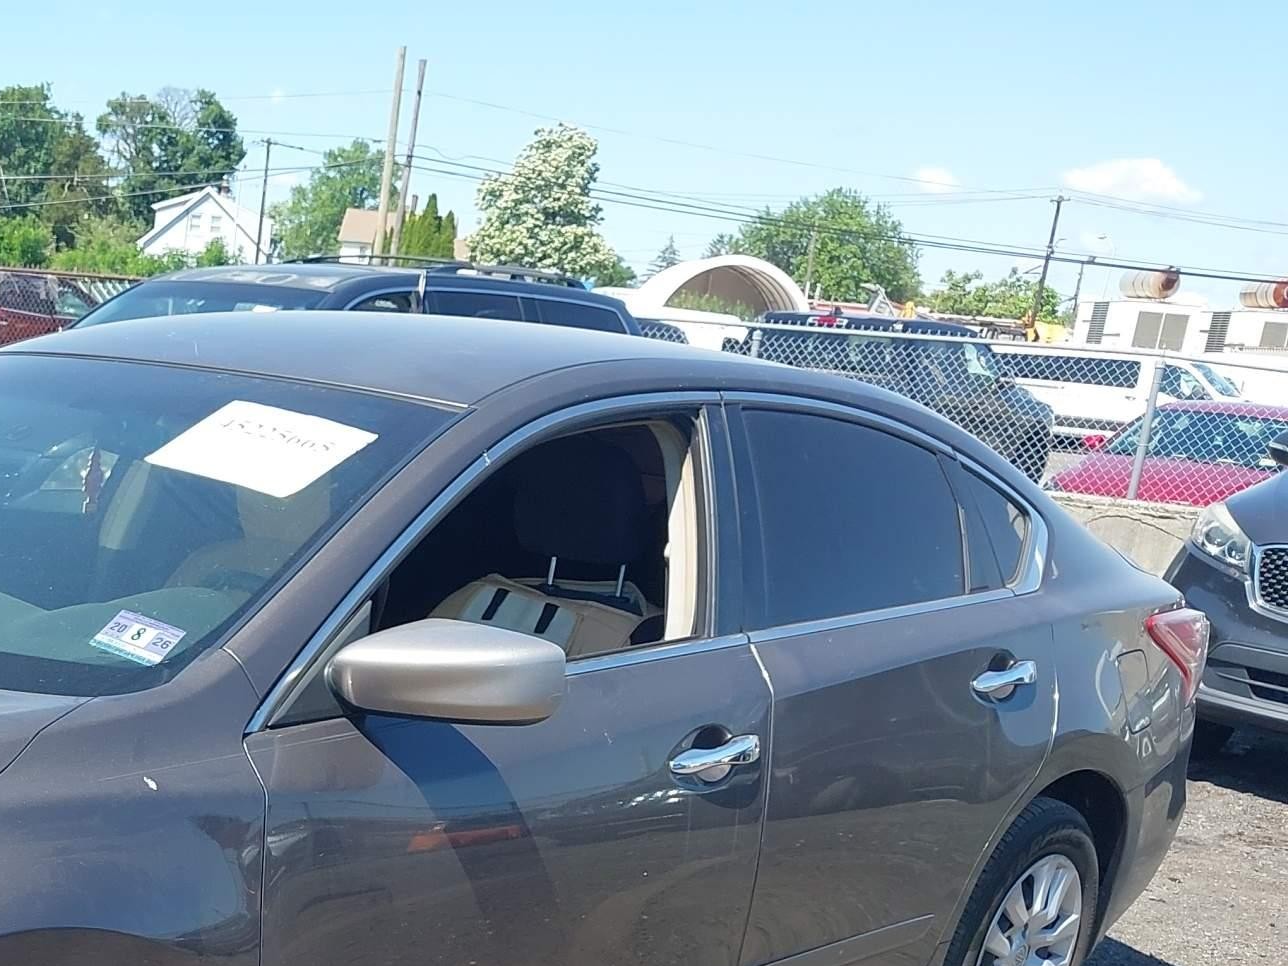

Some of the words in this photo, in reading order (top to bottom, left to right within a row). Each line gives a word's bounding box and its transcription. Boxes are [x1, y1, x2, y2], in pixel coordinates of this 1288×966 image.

[110, 621, 128, 634] 20
[130, 627, 147, 641] 8
[152, 637, 172, 650] 26
